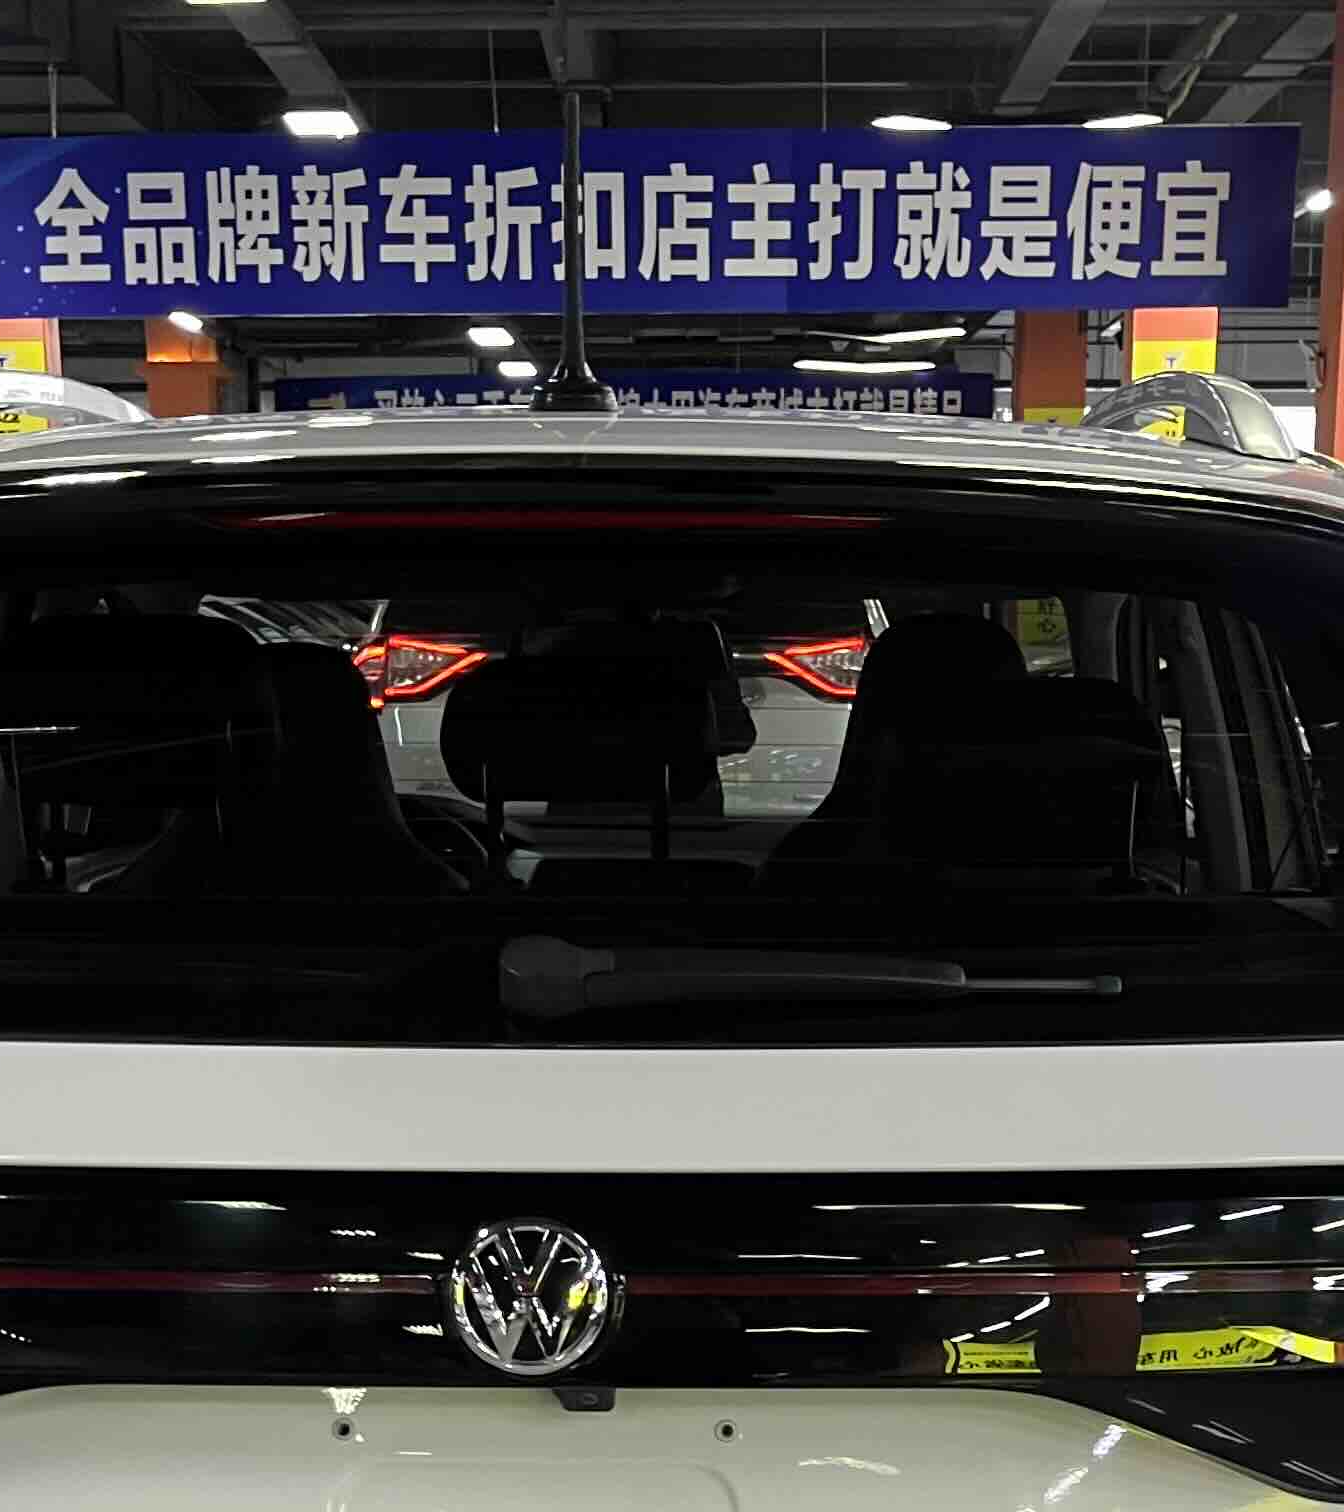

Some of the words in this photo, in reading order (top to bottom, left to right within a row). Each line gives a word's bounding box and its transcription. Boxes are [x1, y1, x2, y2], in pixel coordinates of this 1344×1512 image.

[34, 160, 1232, 286] 全品牌新车折扣店主打就是便宜
